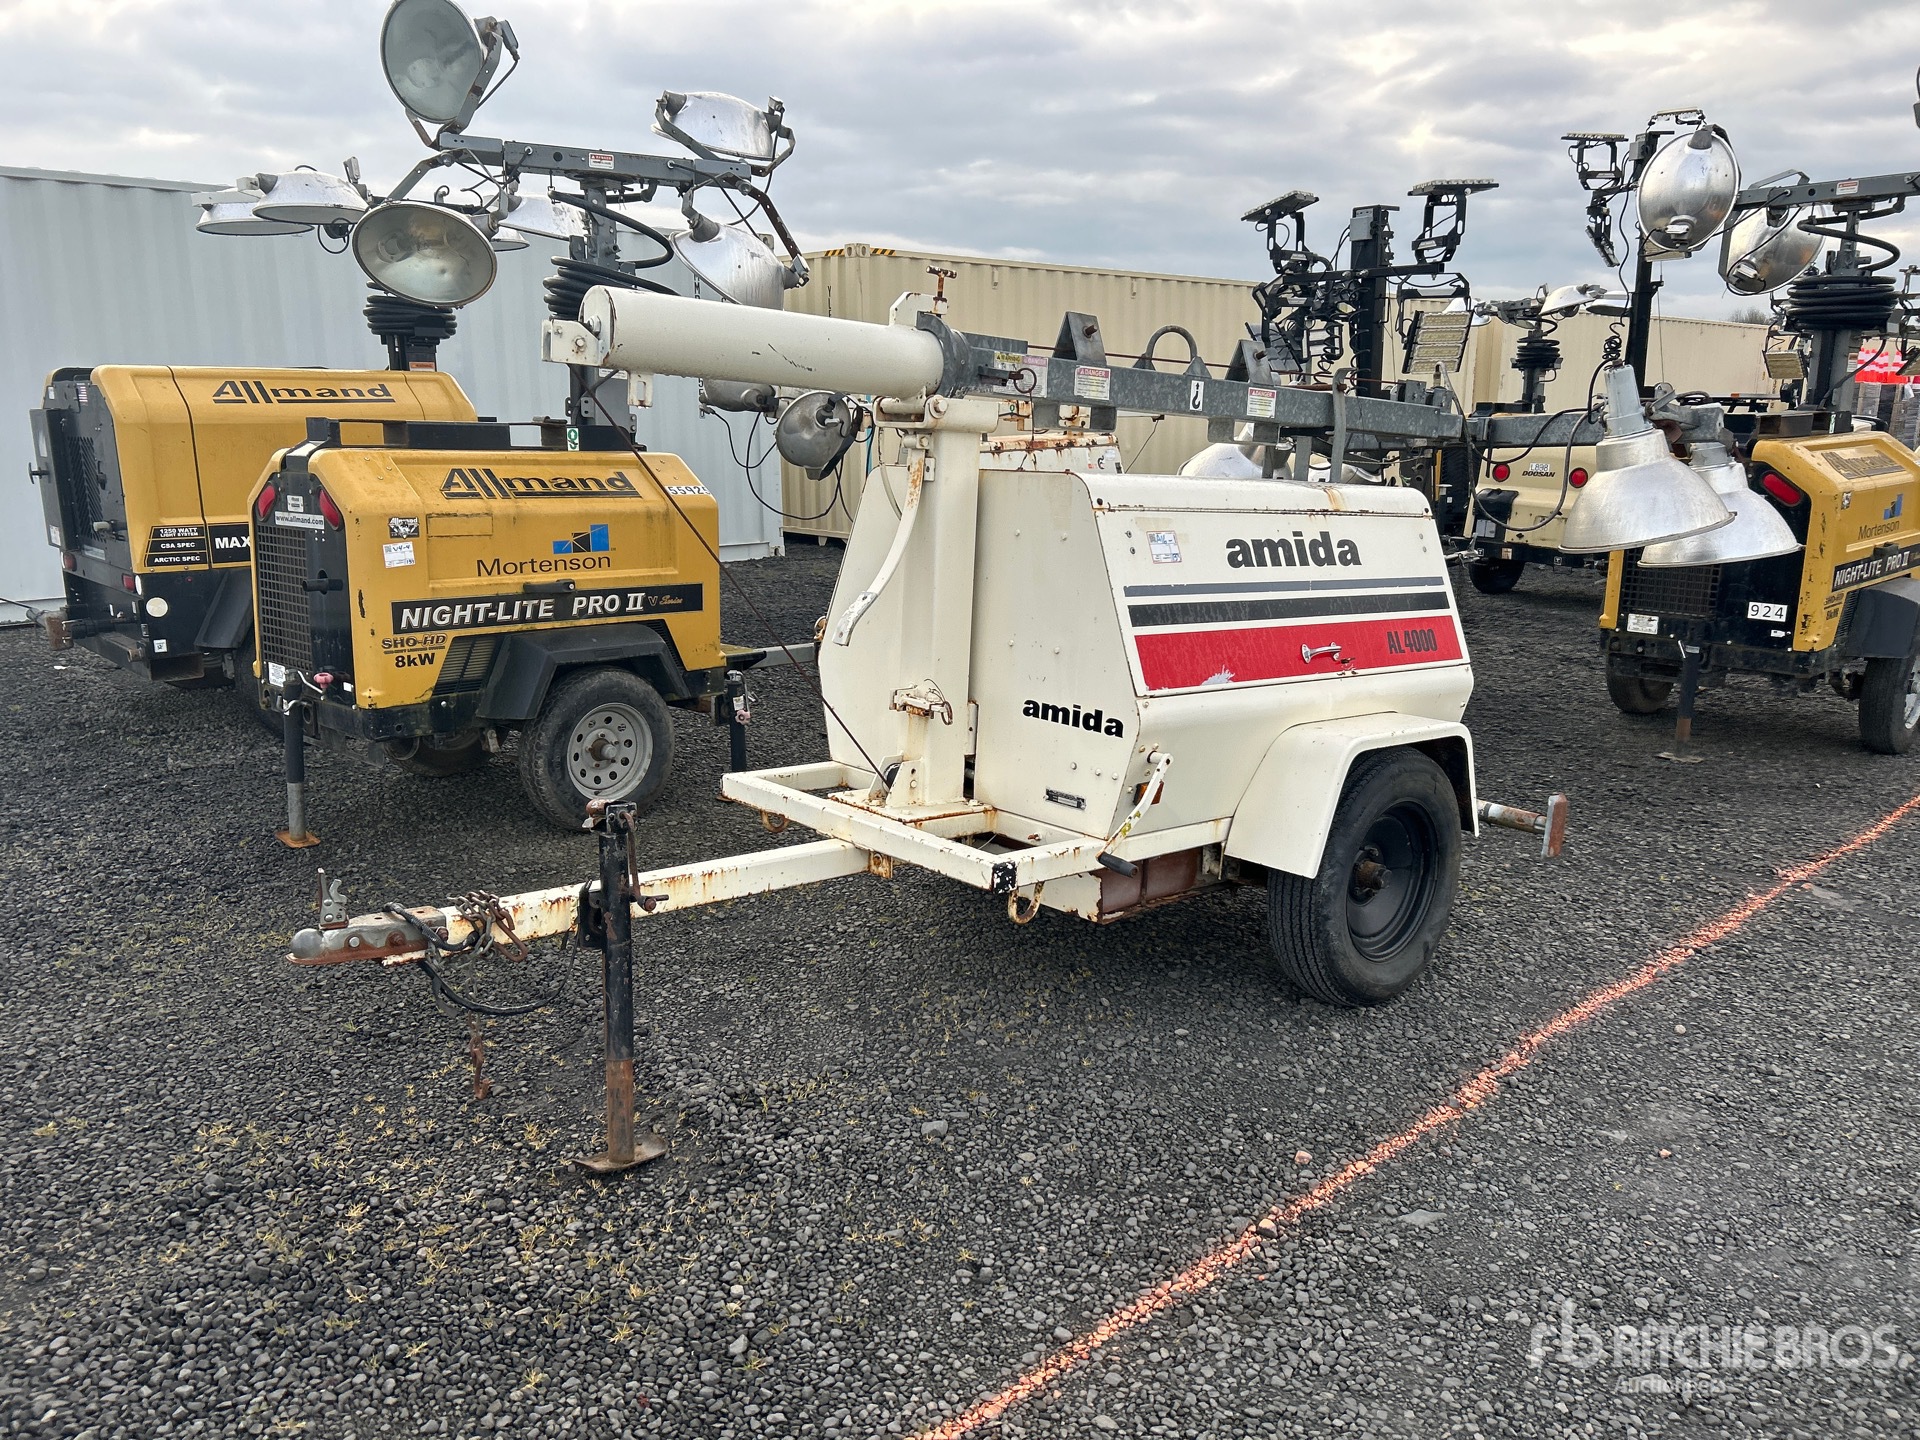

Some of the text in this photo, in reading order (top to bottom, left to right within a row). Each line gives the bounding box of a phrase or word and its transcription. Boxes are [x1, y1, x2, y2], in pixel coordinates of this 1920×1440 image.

[1085, 368, 1106, 377] DANGER
[212, 381, 396, 404] Allmand
[440, 468, 643, 500] Allmand
[1521, 470, 1556, 478] DOOSAN
[275, 515, 324, 526] www.allmand.com
[1857, 520, 1900, 541] Mortenson
[214, 535, 251, 549] MAX
[1225, 530, 1363, 569] amida
[476, 555, 612, 577] Mortenson
[1834, 559, 1883, 587] NIGHT-LITE
[1885, 553, 1902, 571] PRO
[400, 599, 555, 629] NIGHT-LITE
[572, 594, 620, 616] PRO
[647, 596, 658, 606] V
[1750, 604, 1785, 619] 924
[381, 633, 447, 649] SHO-HD
[1386, 628, 1438, 655] AL 4000
[395, 652, 435, 668] 8kW
[1022, 699, 1124, 739] amida
